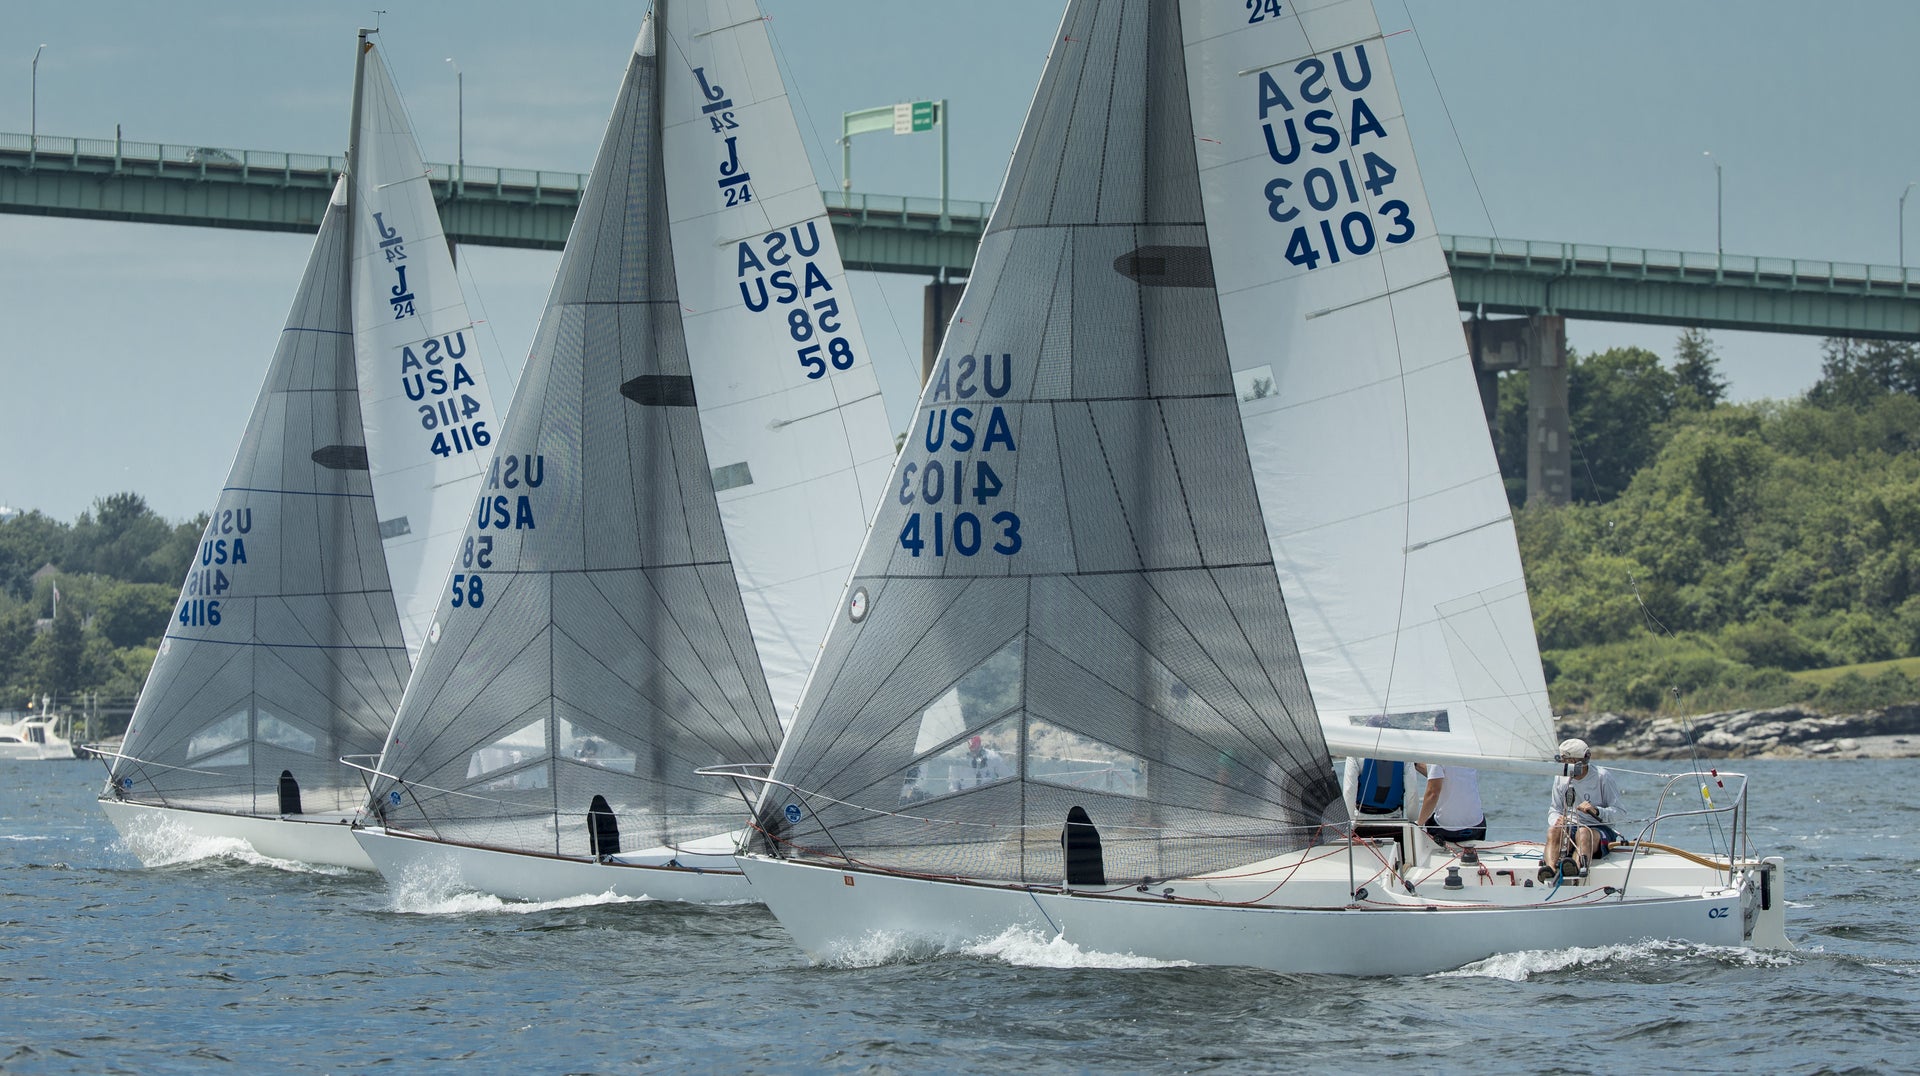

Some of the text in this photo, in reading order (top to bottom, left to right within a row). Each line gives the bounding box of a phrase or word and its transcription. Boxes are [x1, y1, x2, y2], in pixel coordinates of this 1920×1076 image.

[1246, 0, 1282, 24] 24
[1262, 97, 1388, 165] USA
[719, 136, 739, 176] J
[723, 183, 752, 208] 24
[1284, 199, 1416, 271] 4103
[391, 265, 408, 296] J
[739, 261, 833, 313] USA
[393, 301, 415, 320] 24
[797, 336, 854, 380] 58
[402, 362, 475, 401] USA
[430, 421, 491, 458] 4116
[925, 406, 1017, 454] USA
[477, 495, 536, 530] USA
[899, 510, 1023, 558] 4103
[202, 538, 248, 567] USA
[451, 574, 485, 609] 58
[178, 599, 222, 627] 4116
[1708, 906, 1730, 919] OZ
